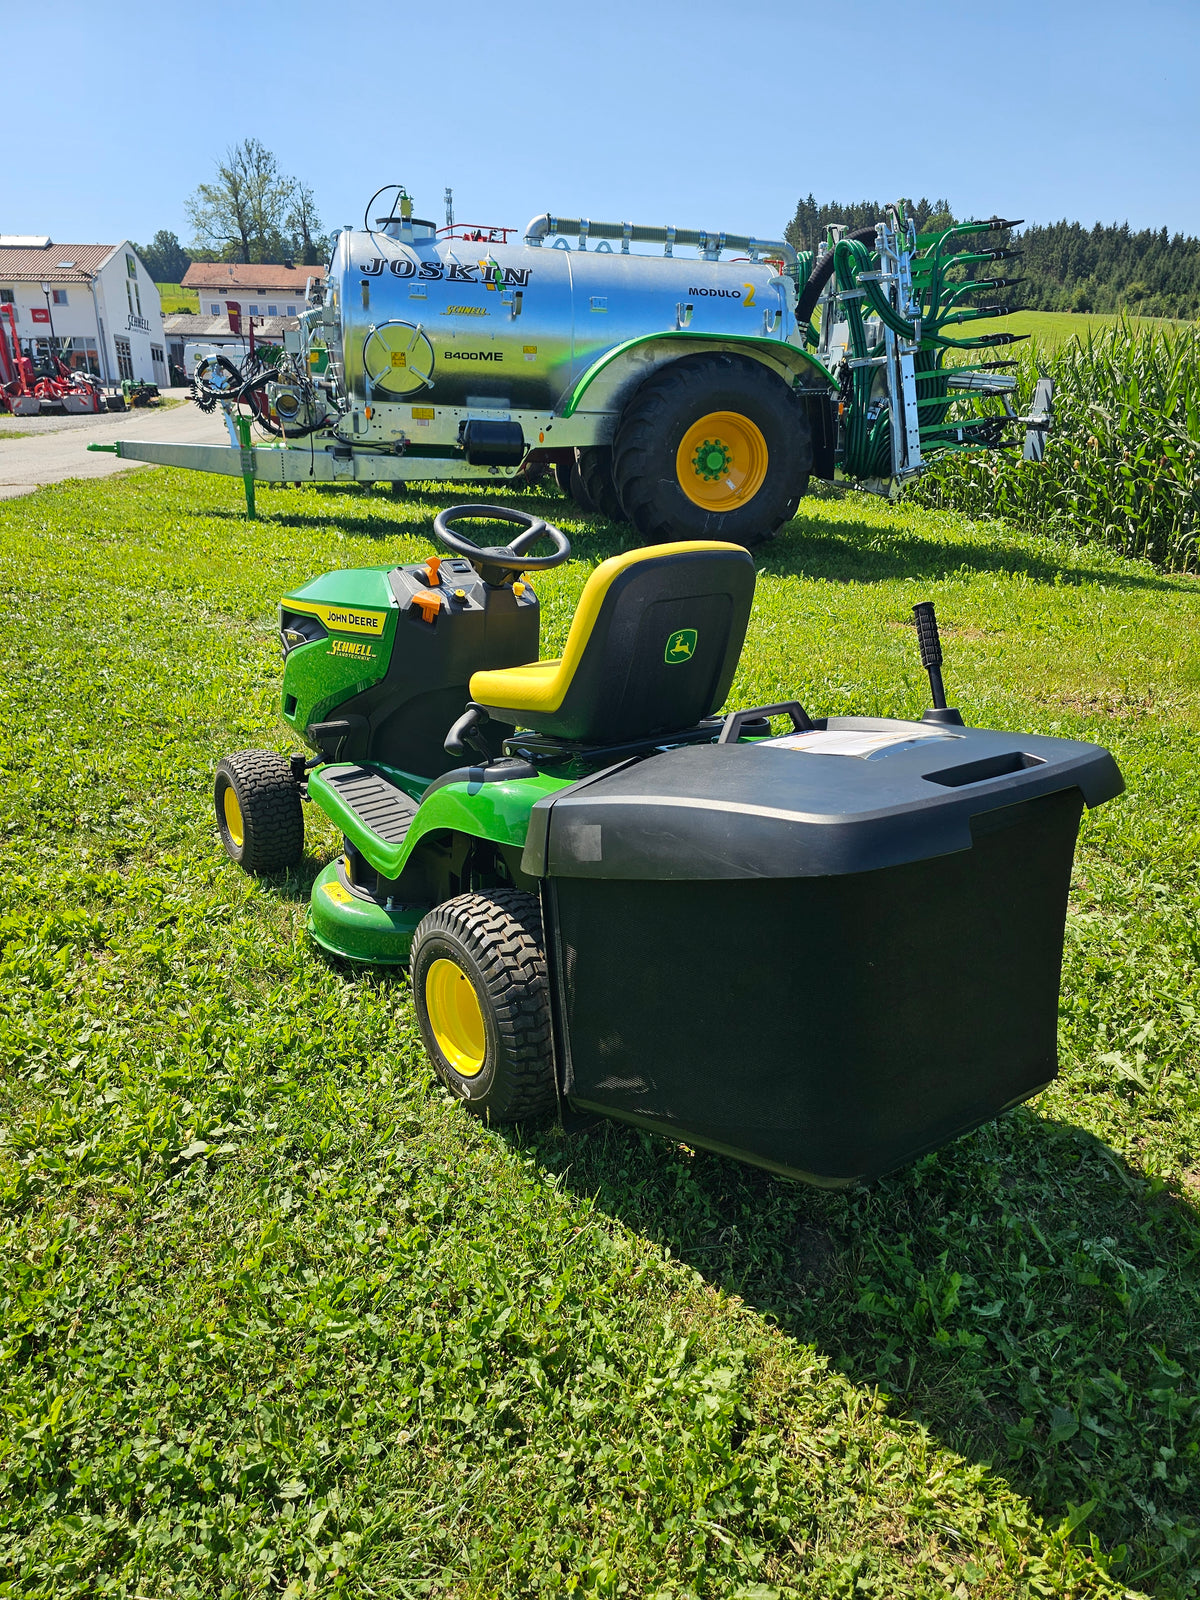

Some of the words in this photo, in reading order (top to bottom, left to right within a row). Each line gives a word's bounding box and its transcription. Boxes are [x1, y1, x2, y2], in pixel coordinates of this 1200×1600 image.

[359, 257, 533, 287] JOSKIN
[688, 287, 741, 299] MODULO
[743, 283, 756, 307] 2
[444, 351, 503, 362] 8400ME
[327, 611, 347, 623] JOHN
[348, 613, 378, 628] DEERE
[329, 640, 375, 657] SCHNELL
